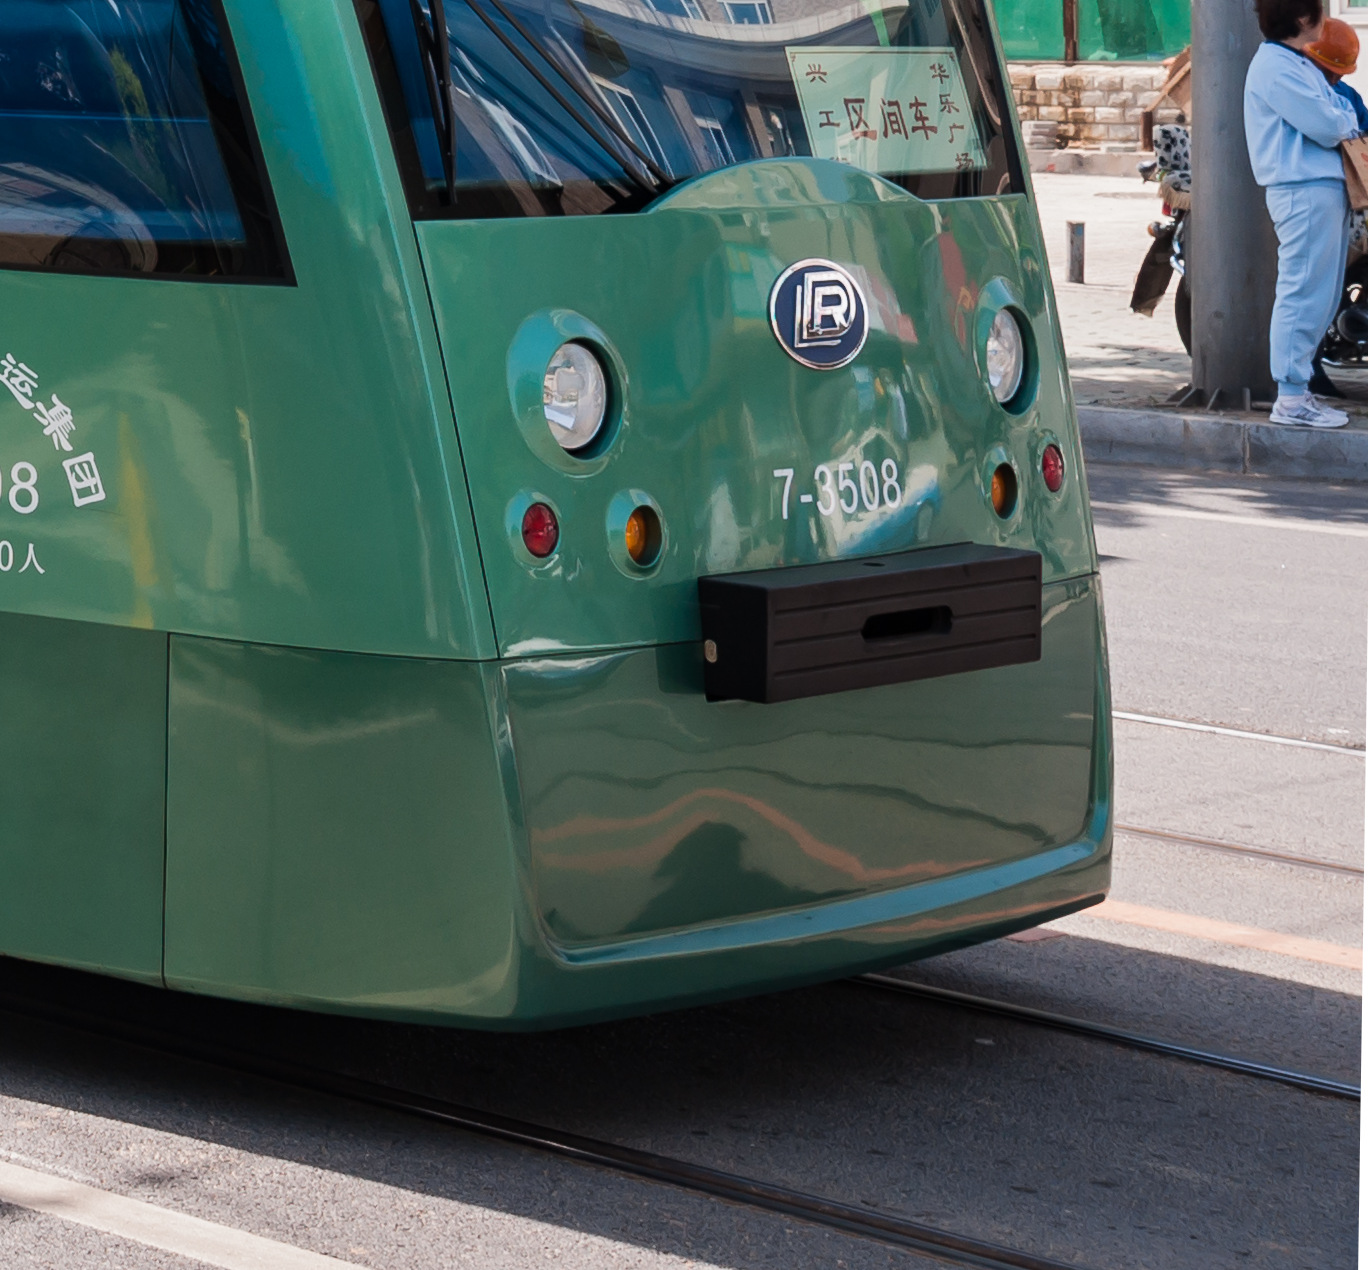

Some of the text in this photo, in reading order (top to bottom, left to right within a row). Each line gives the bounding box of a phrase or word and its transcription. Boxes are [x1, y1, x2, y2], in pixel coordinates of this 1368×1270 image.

[843, 95, 938, 142] 区间车
[929, 62, 975, 171] 华乐广场
[773, 457, 903, 520] 7-3508
